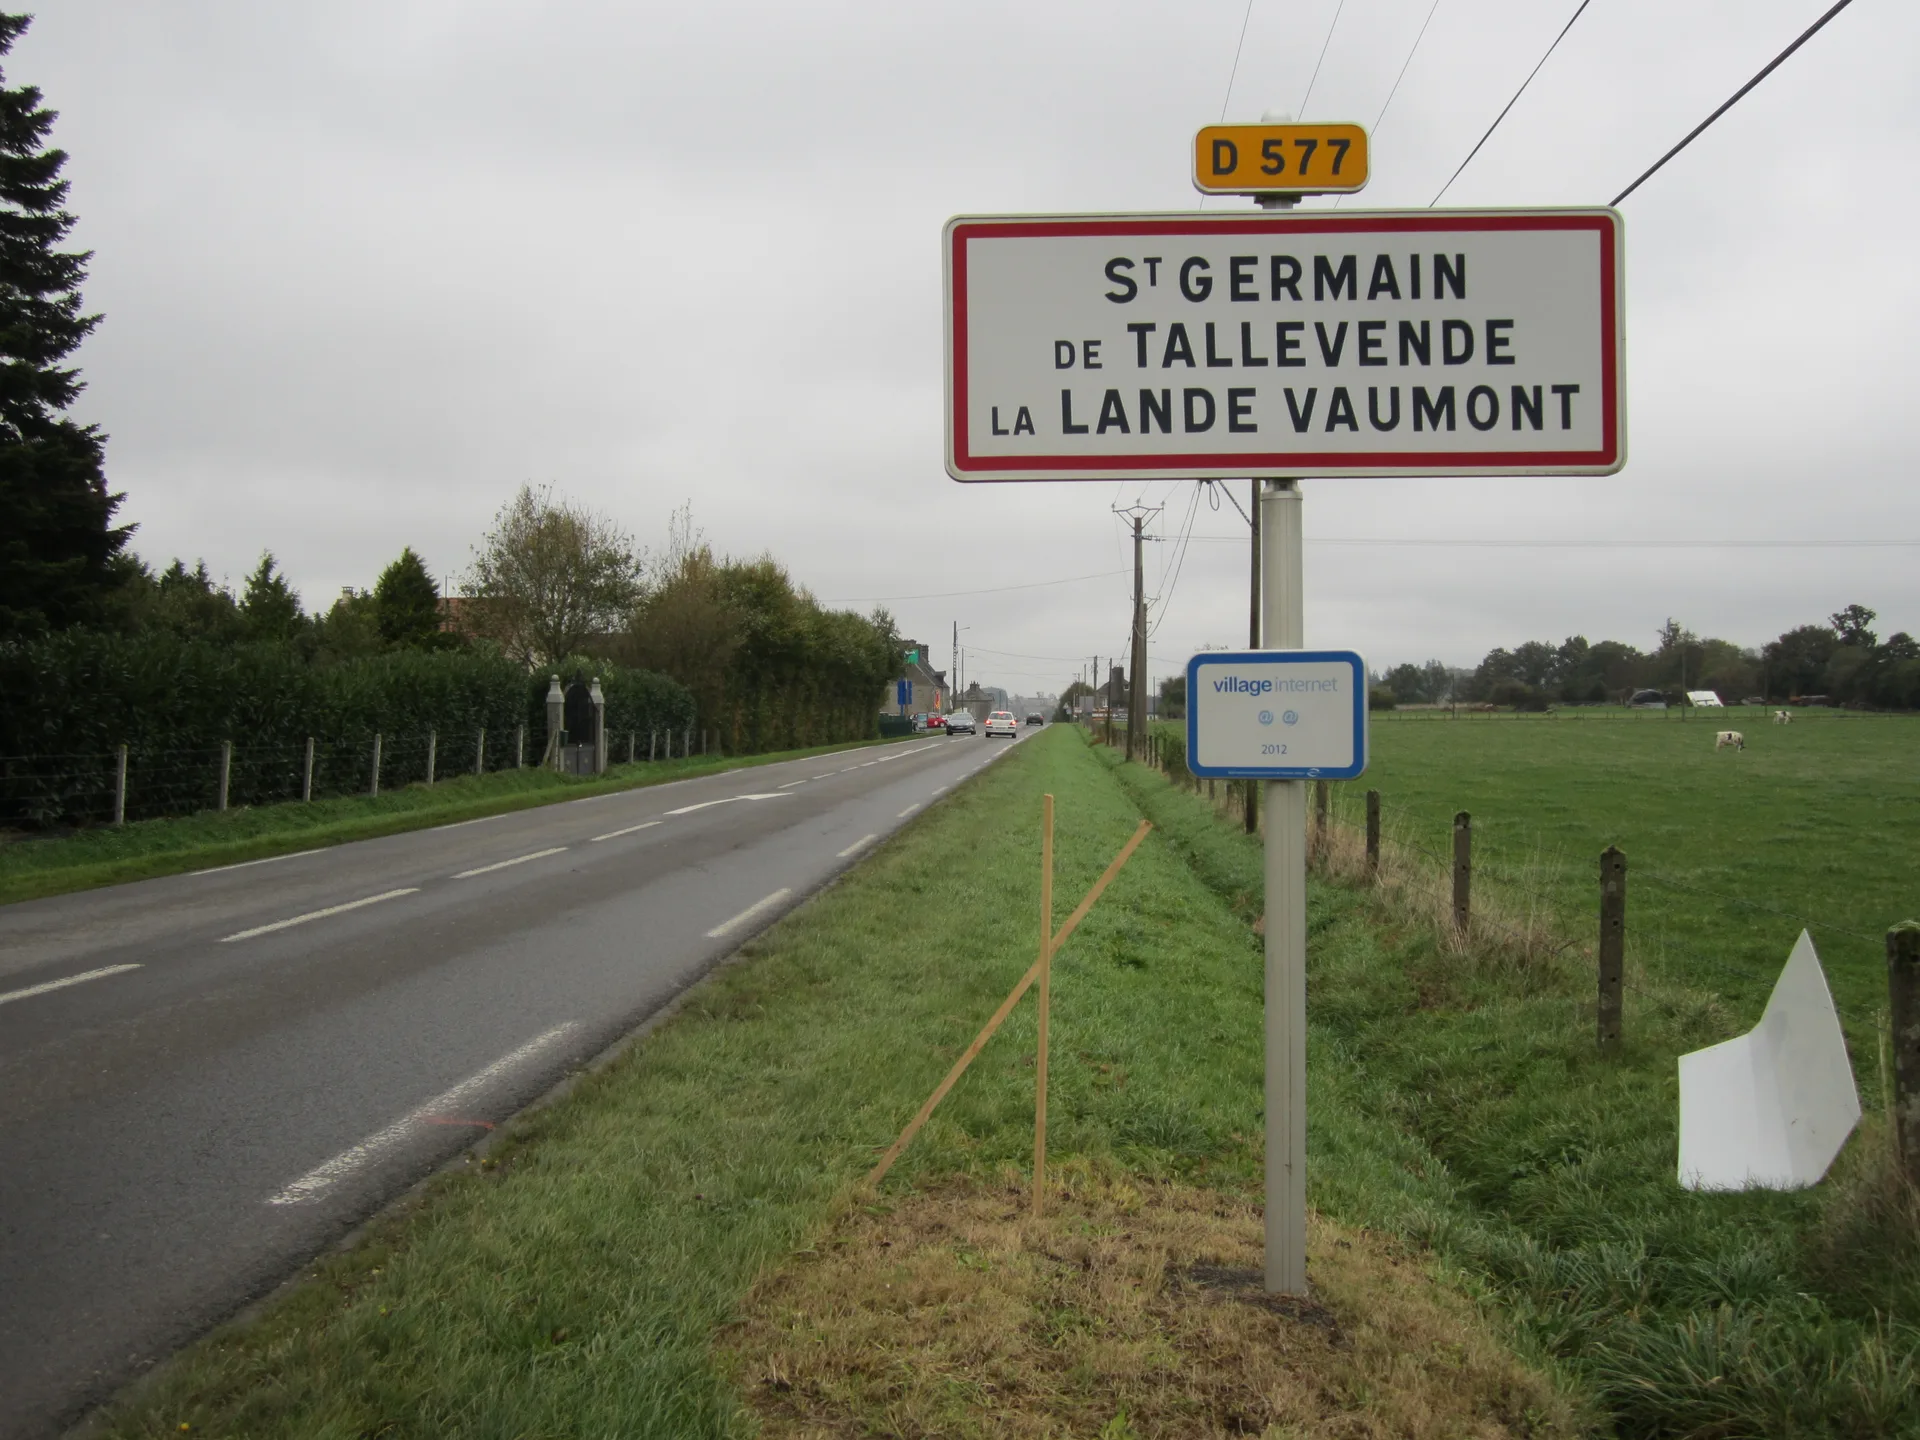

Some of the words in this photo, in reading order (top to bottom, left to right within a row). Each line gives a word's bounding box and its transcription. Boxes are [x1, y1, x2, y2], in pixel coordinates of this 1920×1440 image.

[1212, 138, 1239, 176] D
[1260, 138, 1352, 176] 577
[1179, 253, 1466, 303] GERMAIN
[1054, 339, 1103, 370] DE
[1126, 318, 1516, 369] TALLEVENDE
[991, 405, 1036, 436] LA
[1061, 387, 1258, 435] LANDE
[1283, 383, 1581, 433] VAUMONT
[1261, 744, 1288, 755] 2012
